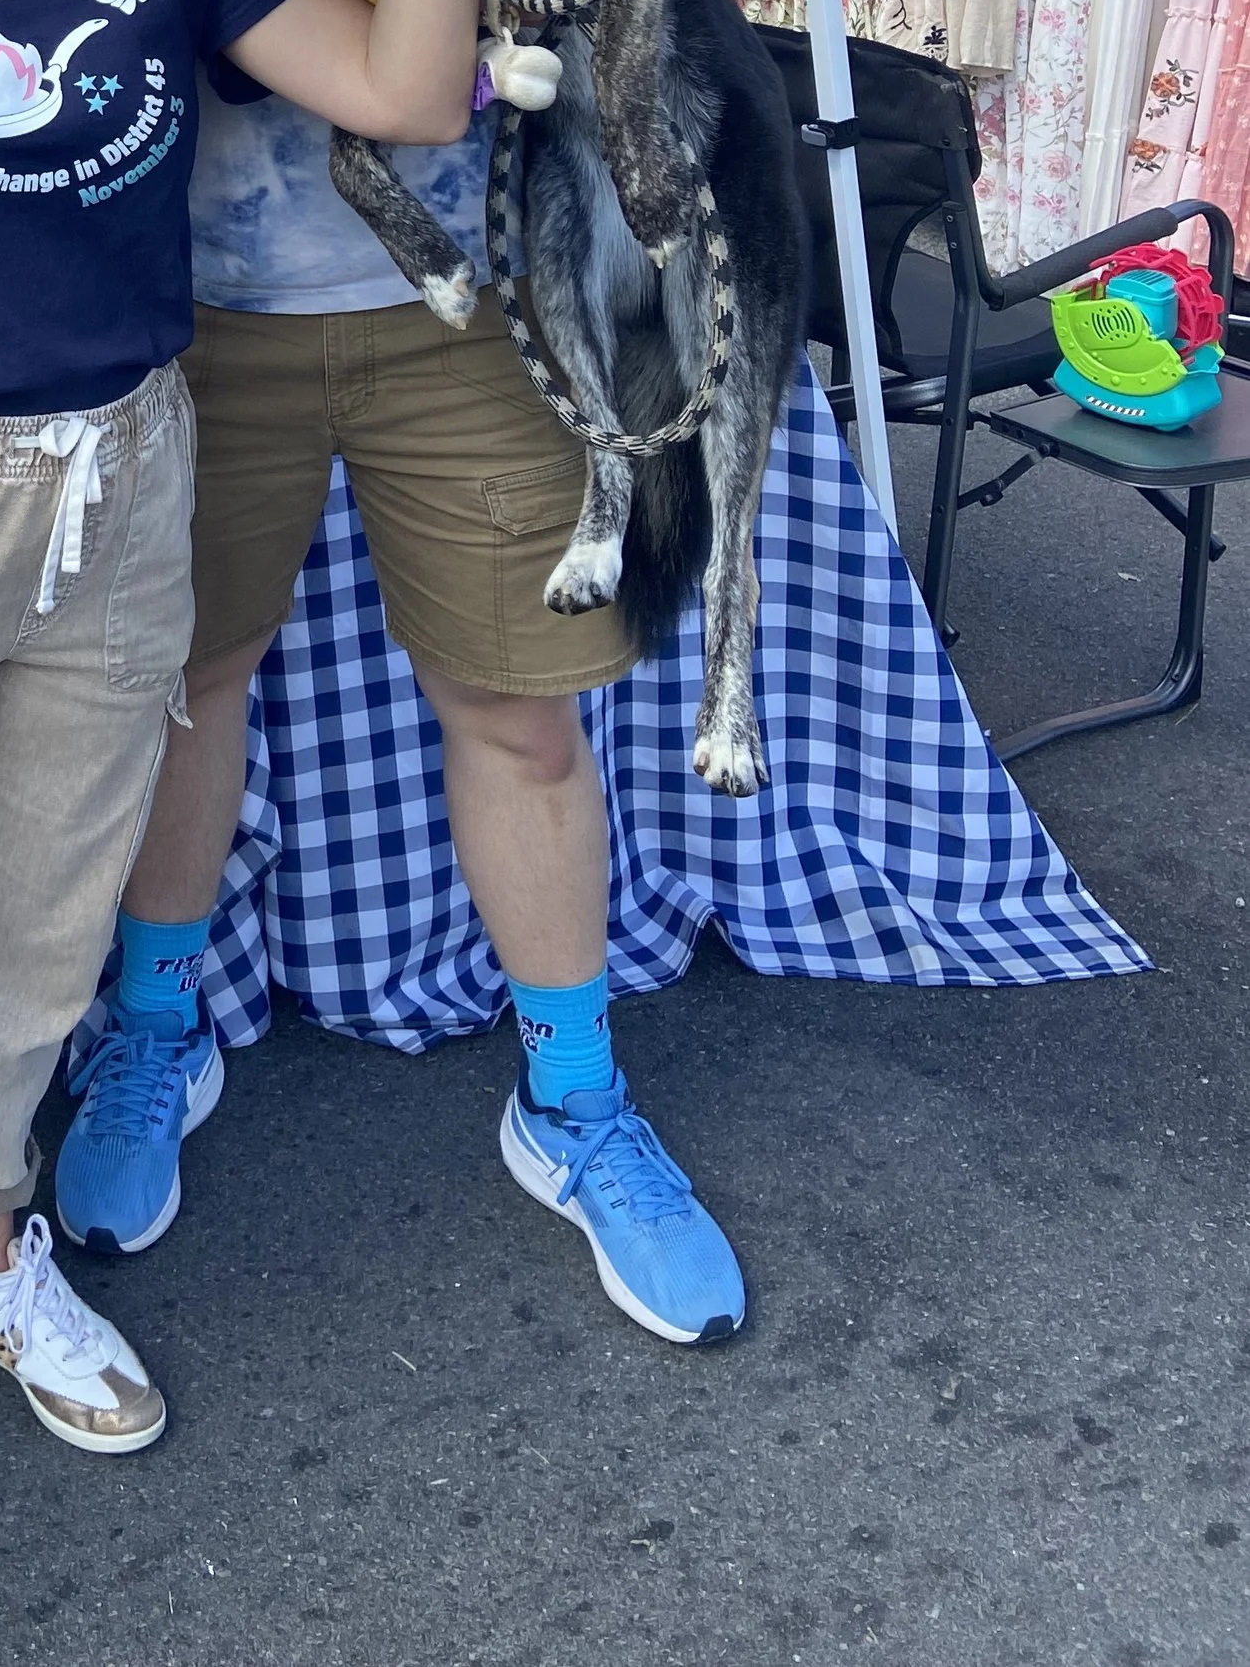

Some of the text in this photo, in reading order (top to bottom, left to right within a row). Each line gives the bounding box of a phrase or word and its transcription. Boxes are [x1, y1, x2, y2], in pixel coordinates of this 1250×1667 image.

[73, 156, 100, 182] in
[100, 94, 165, 167] District
[144, 57, 167, 91] 45
[77, 94, 185, 208] November 3
